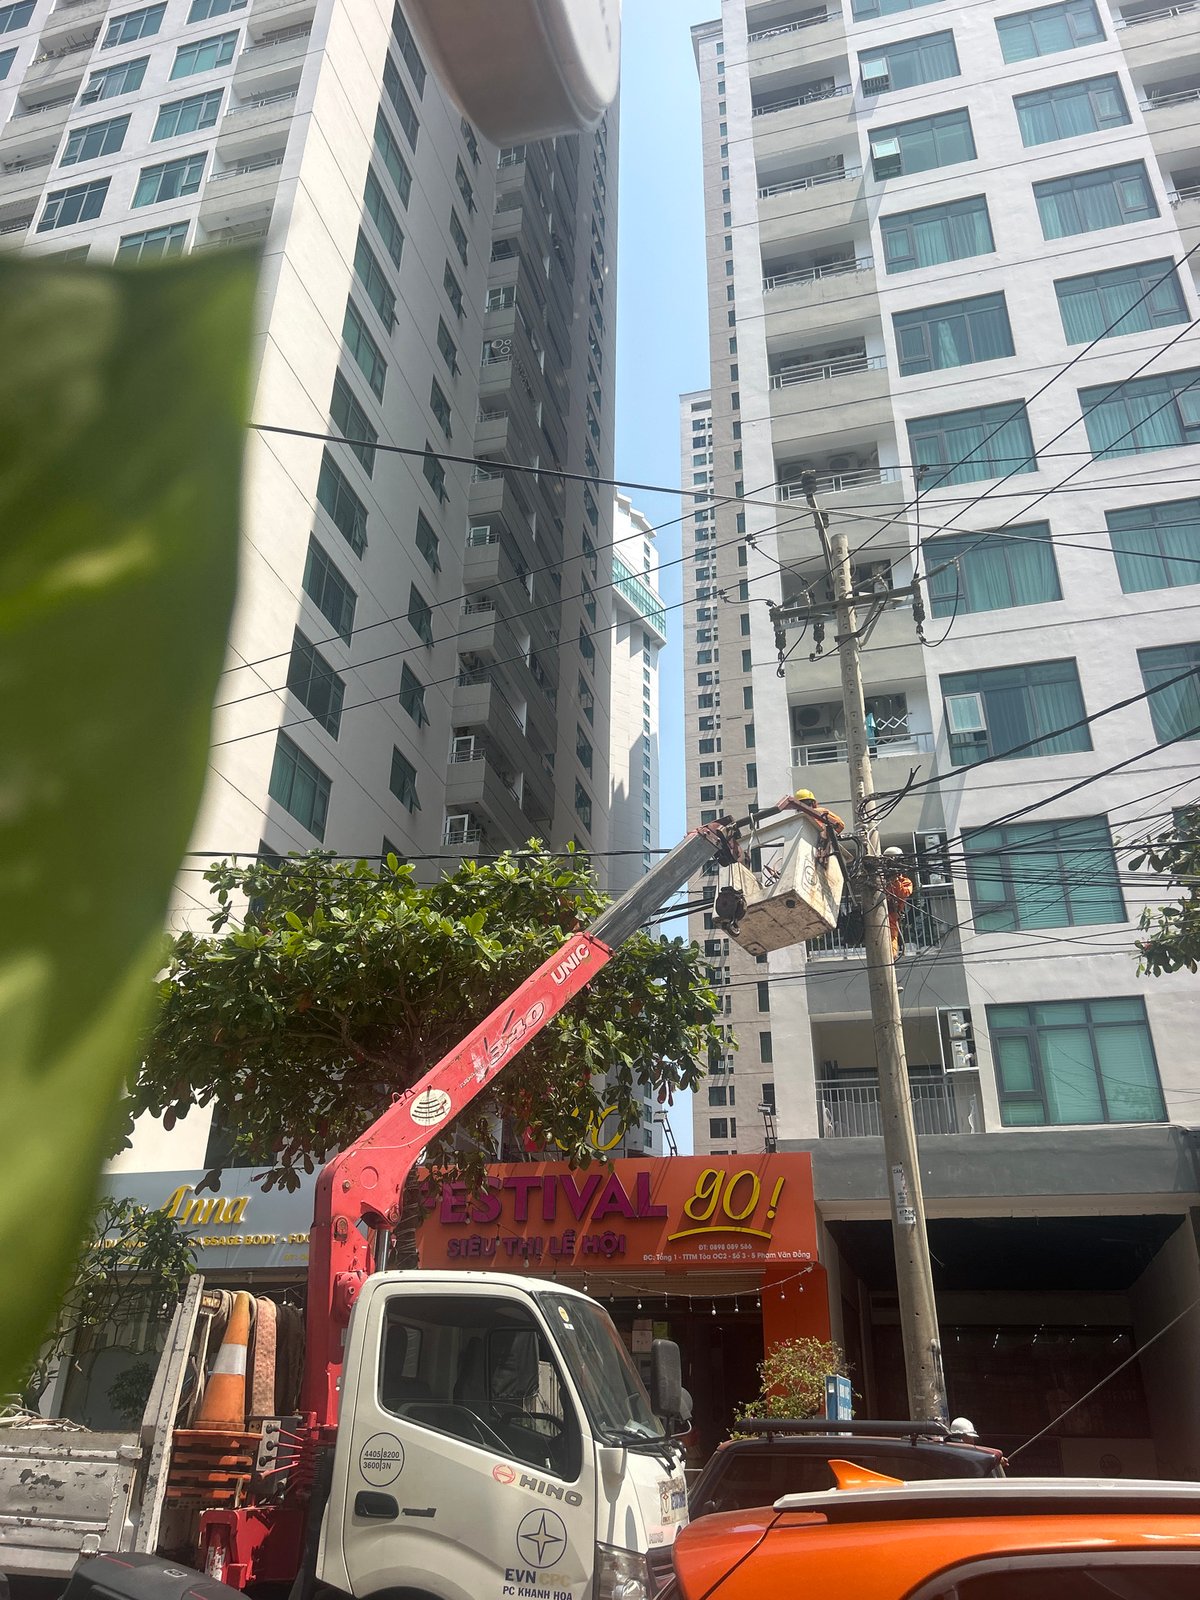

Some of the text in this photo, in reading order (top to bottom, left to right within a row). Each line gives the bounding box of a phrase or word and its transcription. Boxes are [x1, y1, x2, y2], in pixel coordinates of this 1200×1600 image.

[550, 943, 591, 985] UNIC
[160, 1184, 251, 1226] Anna
[243, 1233, 279, 1245] BODY
[447, 1233, 496, 1258] SIÊU
[582, 1231, 625, 1259] HỘI
[712, 1252, 727, 1260] OC2
[364, 1450, 400, 1459] 4405 8200
[363, 1461, 392, 1470] 3600 3N
[519, 1474, 583, 1507] HINO
[505, 1568, 571, 1588] EVN CPC
[502, 1585, 515, 1596] PC
[517, 1587, 551, 1600] KHANH
